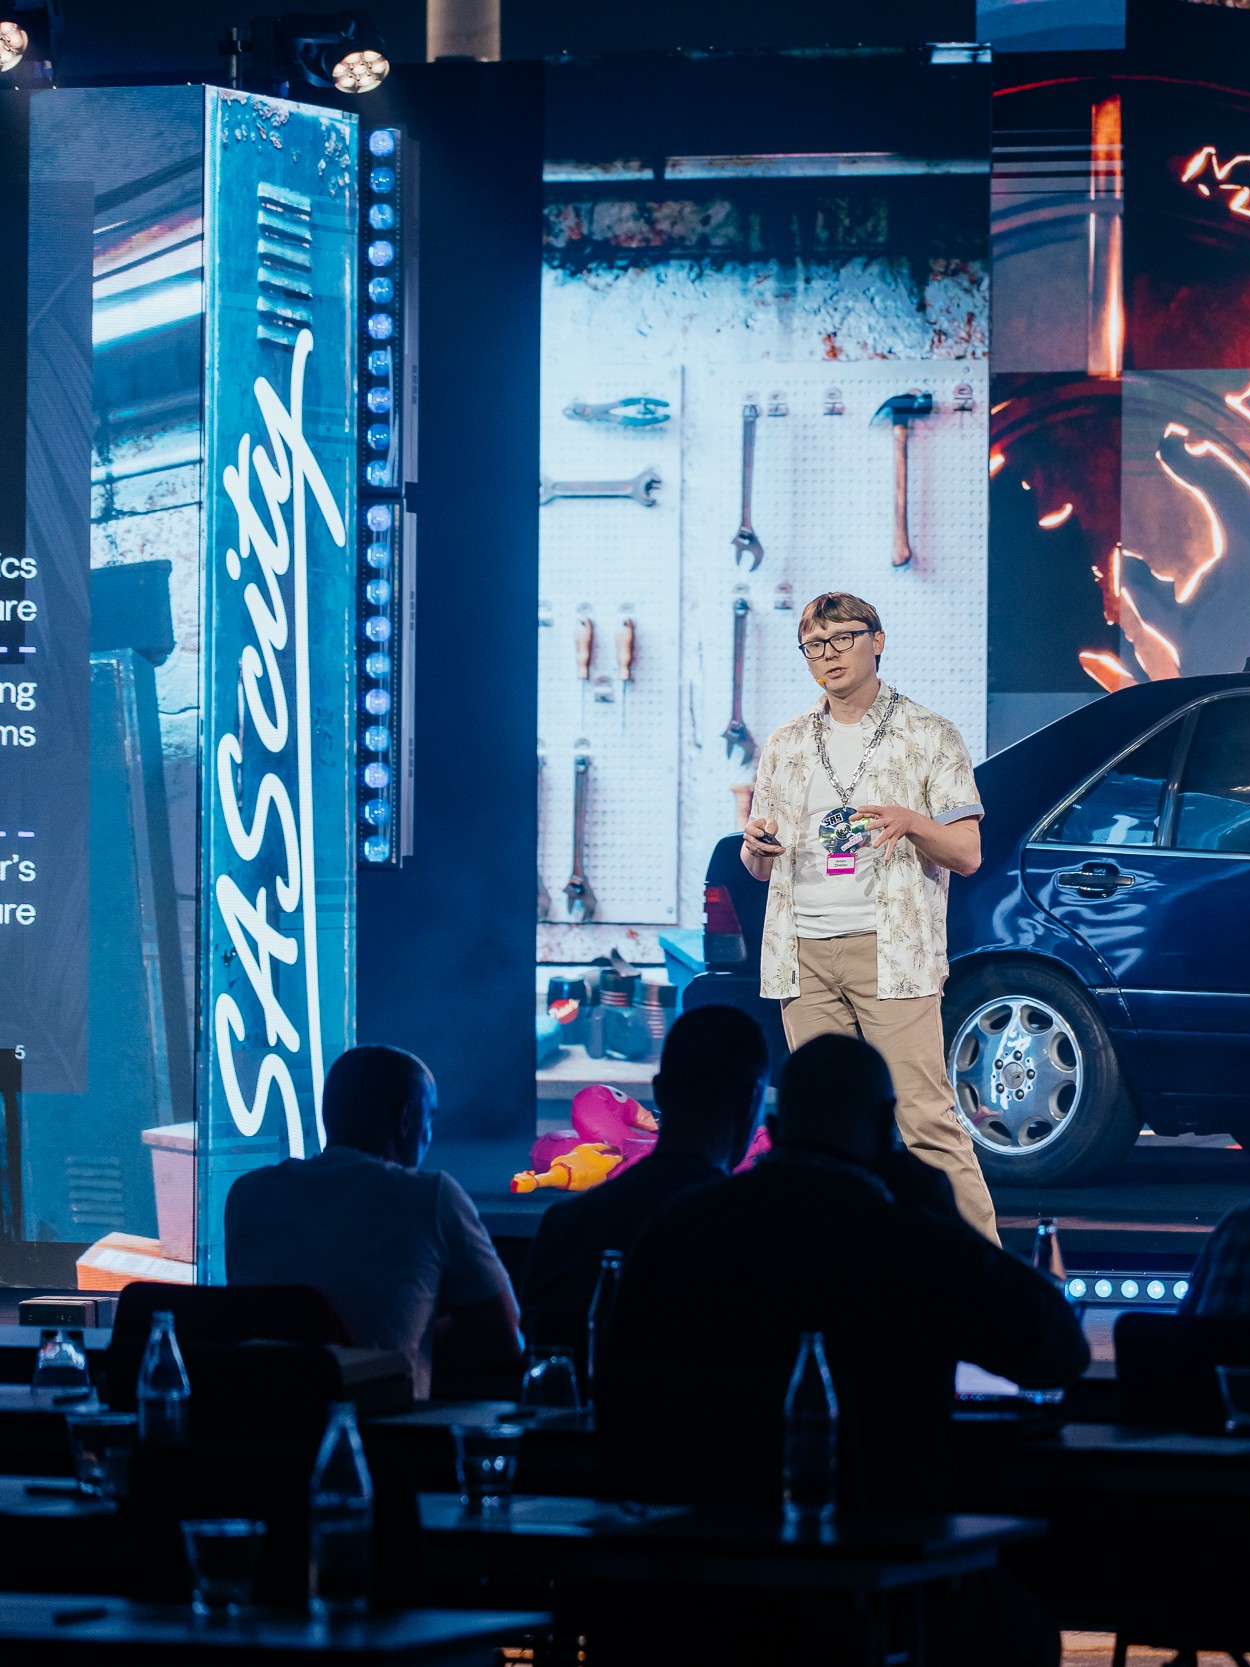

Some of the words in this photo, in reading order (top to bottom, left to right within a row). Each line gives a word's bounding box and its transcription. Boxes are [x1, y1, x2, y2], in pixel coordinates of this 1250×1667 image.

[0, 552, 38, 579] cs
[0, 599, 38, 621] re
[0, 903, 37, 926] re
[14, 1044, 26, 1060] 5
